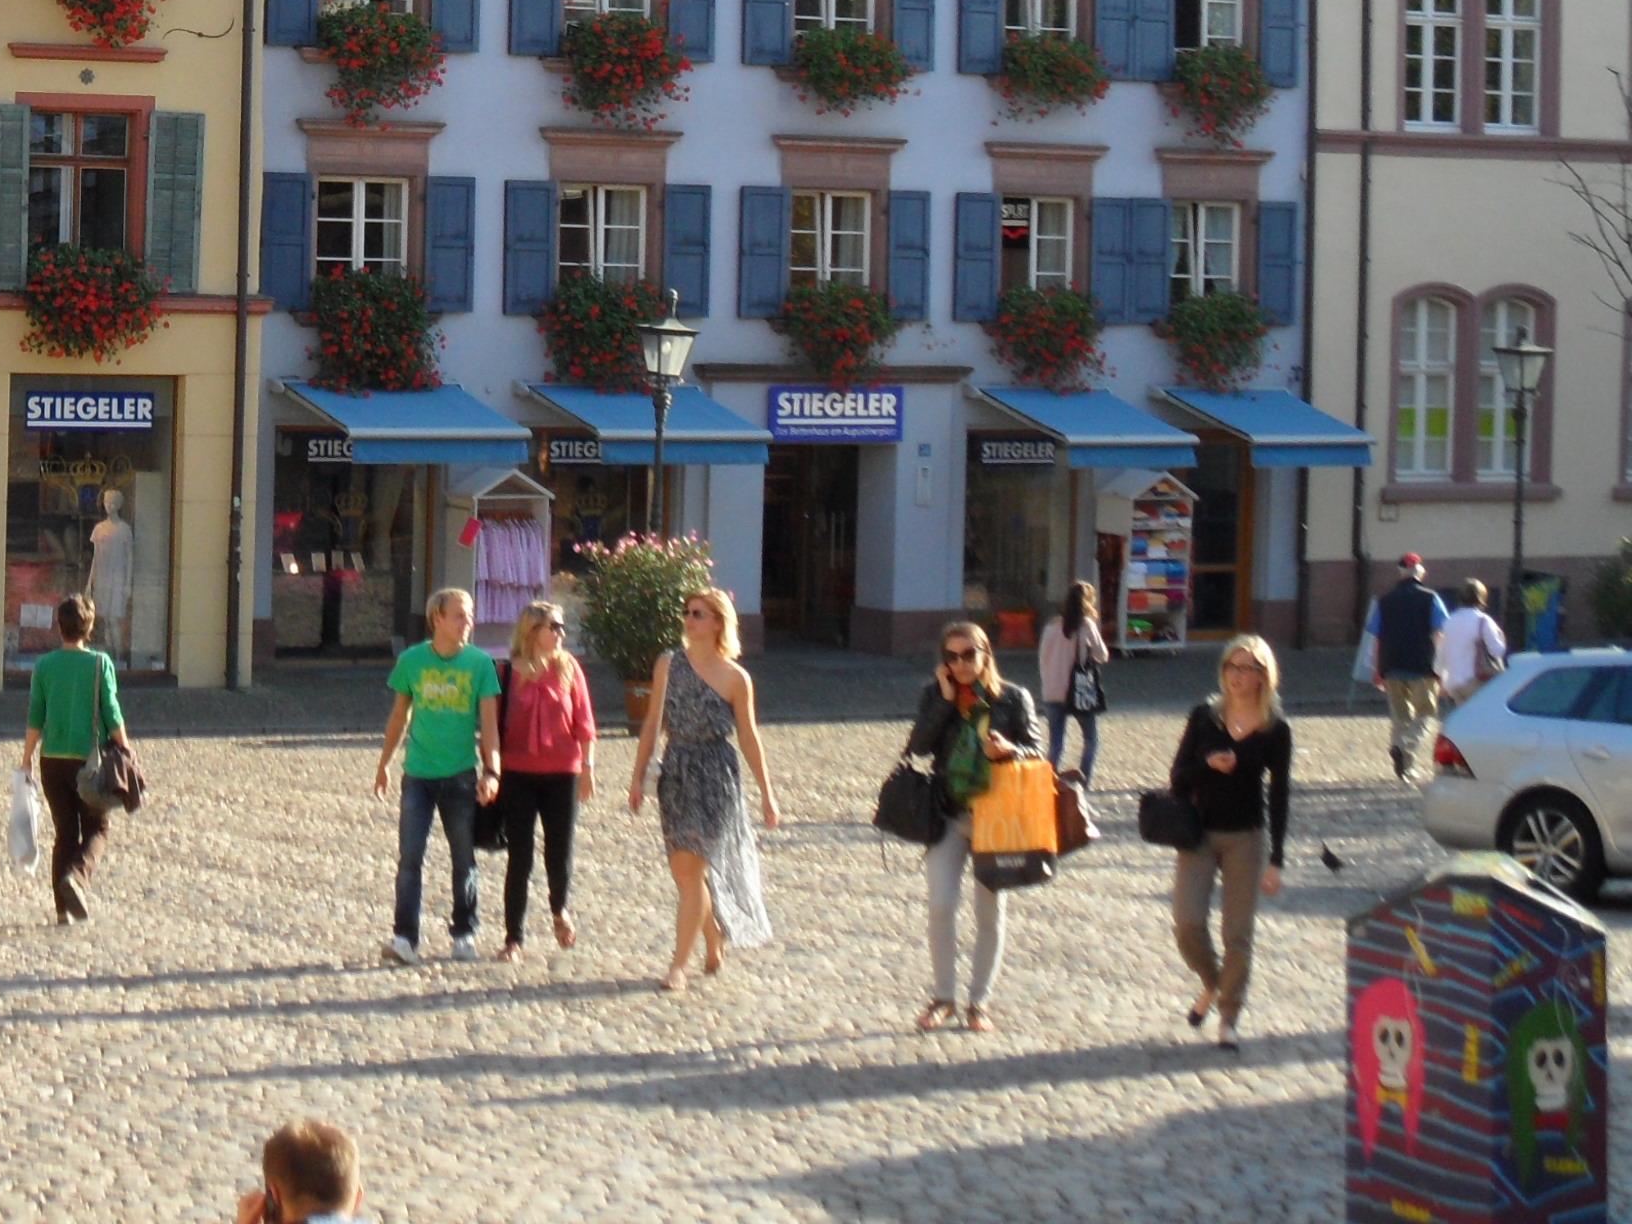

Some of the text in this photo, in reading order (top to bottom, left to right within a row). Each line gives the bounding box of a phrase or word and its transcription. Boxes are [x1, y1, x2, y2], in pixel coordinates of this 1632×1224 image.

[27, 396, 153, 420] STIEGELER
[776, 392, 897, 417] STIEGELER
[982, 441, 1055, 458] STIEGELER
